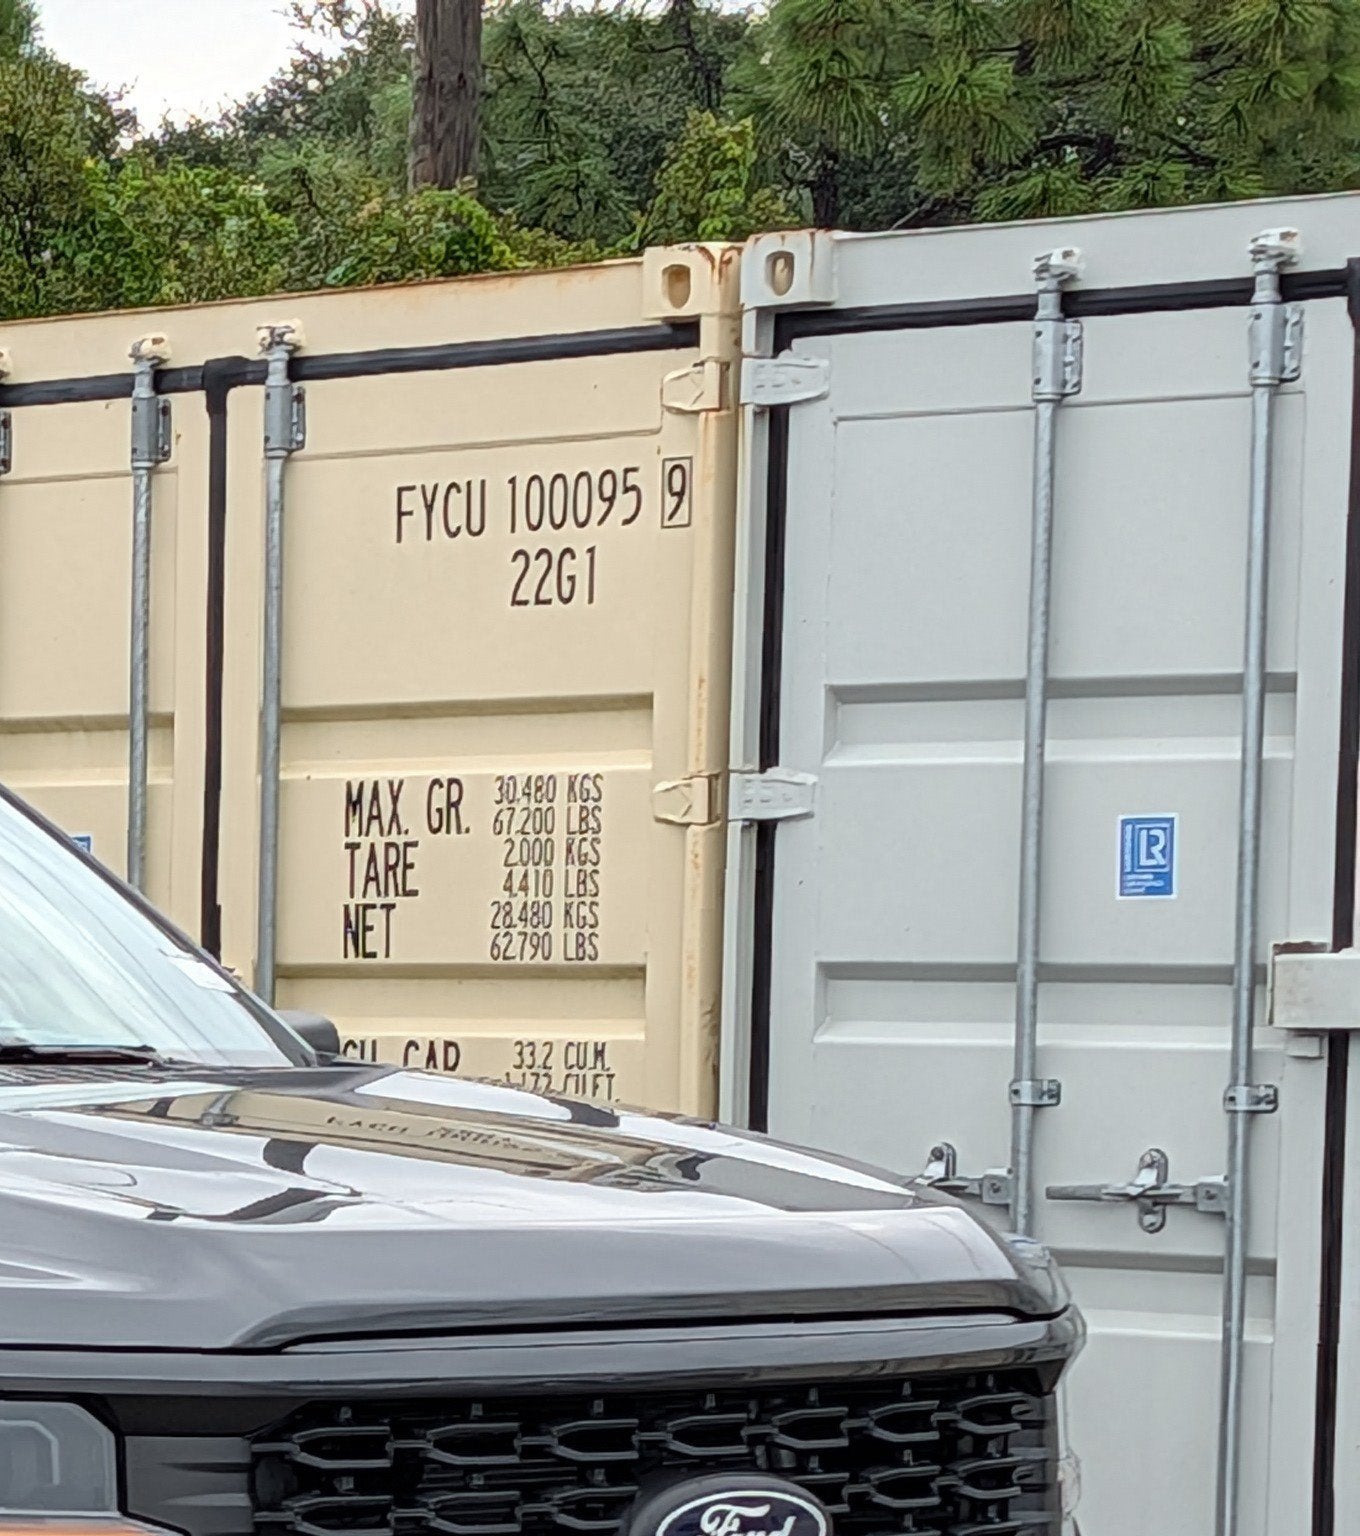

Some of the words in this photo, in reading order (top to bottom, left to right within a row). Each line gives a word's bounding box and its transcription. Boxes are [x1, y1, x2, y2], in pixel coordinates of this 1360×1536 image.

[395, 478, 487, 544] FYCU
[507, 466, 643, 534] 100095
[665, 461, 688, 523] 9
[510, 545, 596, 607] 22G1
[493, 774, 557, 805] 30.480
[566, 773, 604, 803] KGS
[344, 779, 410, 838] MAX.
[426, 777, 471, 835] GR.
[492, 805, 556, 836] 67.200
[566, 805, 603, 836] LBS
[565, 836, 602, 867] KGS
[344, 840, 420, 899] TARE
[563, 868, 600, 898] LBS
[343, 902, 397, 959] NET
[489, 900, 553, 930] 28.480
[563, 900, 599, 929] KGS
[563, 931, 599, 961] LBS
[512, 1040, 553, 1070] 33.2
